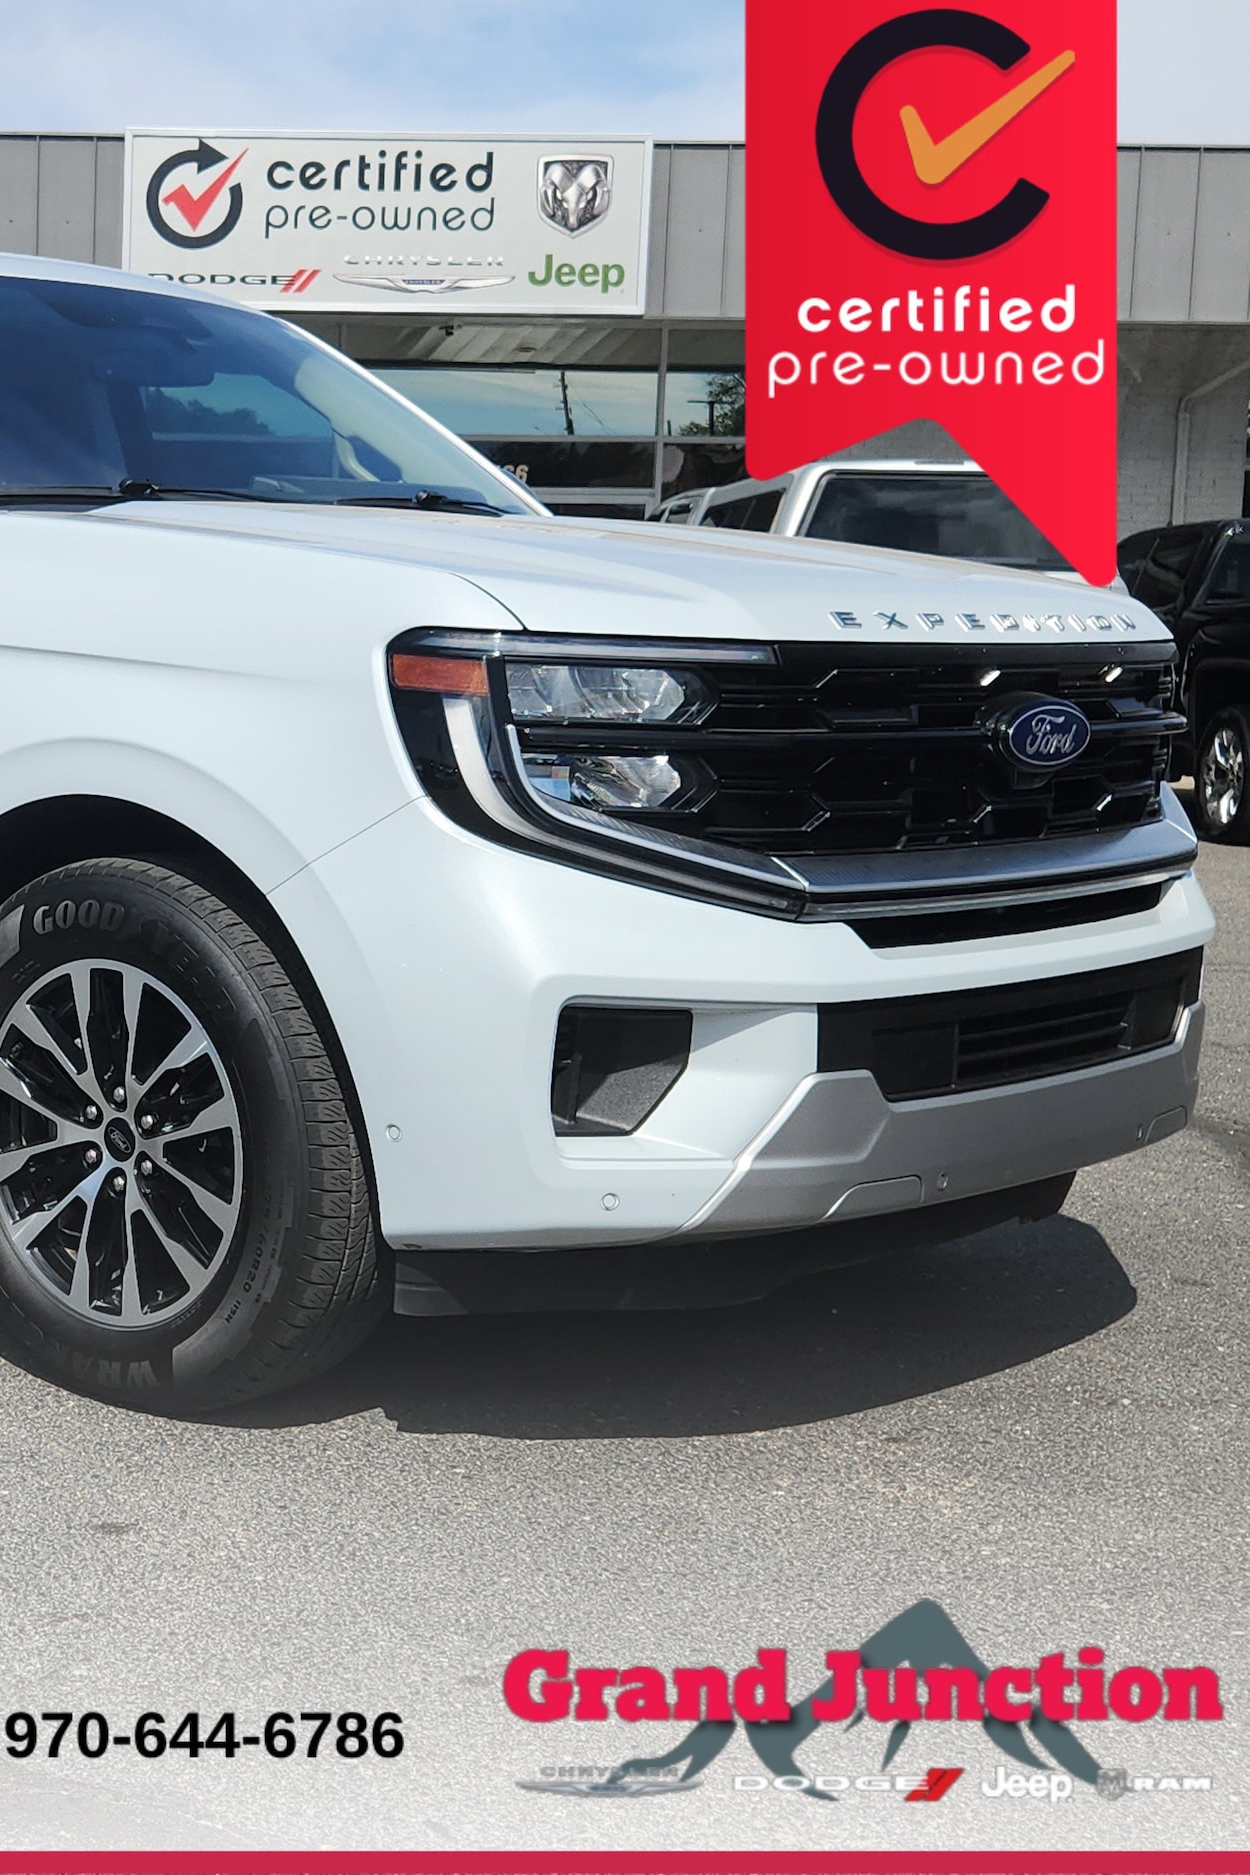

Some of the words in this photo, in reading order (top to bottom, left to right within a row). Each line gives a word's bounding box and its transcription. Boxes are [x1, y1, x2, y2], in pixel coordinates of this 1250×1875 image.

[266, 149, 495, 194] certified
[265, 197, 496, 239] pre-owned
[343, 255, 504, 267] CHRYSLER
[528, 253, 626, 294] Jeep
[828, 610, 1138, 633] EXPEDITION
[1024, 714, 1076, 755] Ford
[33, 899, 125, 936] GOOD
